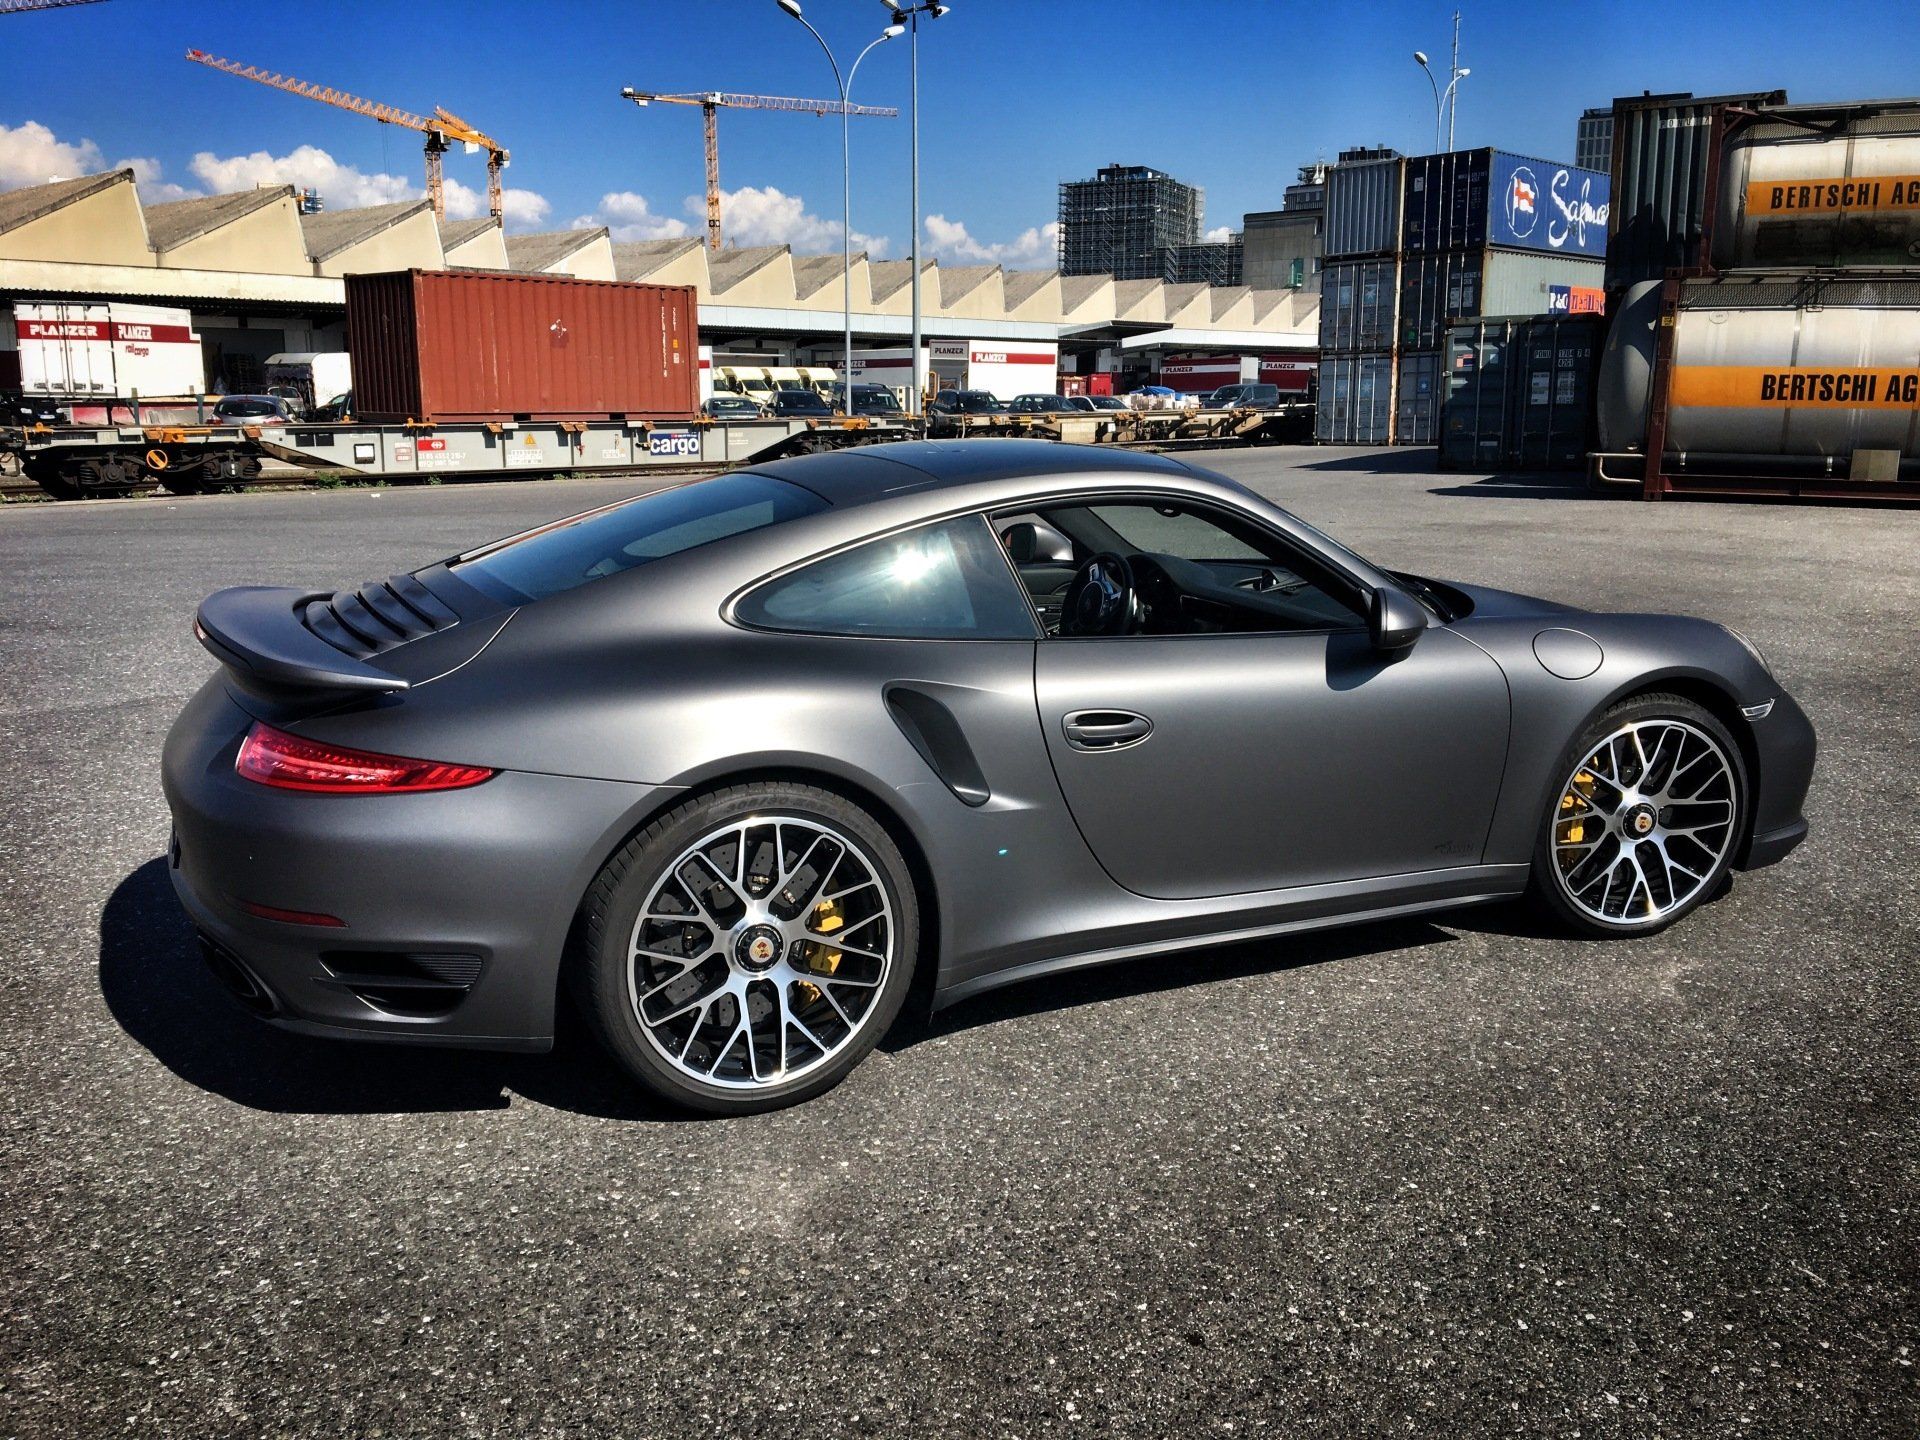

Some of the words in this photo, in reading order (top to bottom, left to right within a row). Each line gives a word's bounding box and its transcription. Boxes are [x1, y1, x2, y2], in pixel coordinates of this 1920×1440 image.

[1770, 182, 1879, 210] BERTSCHI
[1891, 180, 1920, 205] AG
[29, 324, 98, 337] PLANZER
[118, 324, 152, 340] PLANZER
[935, 347, 964, 355] PLANZER
[975, 352, 1007, 363] PLANZER
[836, 360, 866, 369] PLNZER
[1761, 374, 1877, 402] BERTSCHI
[1885, 374, 1919, 403] AG
[650, 437, 699, 456] cargo
